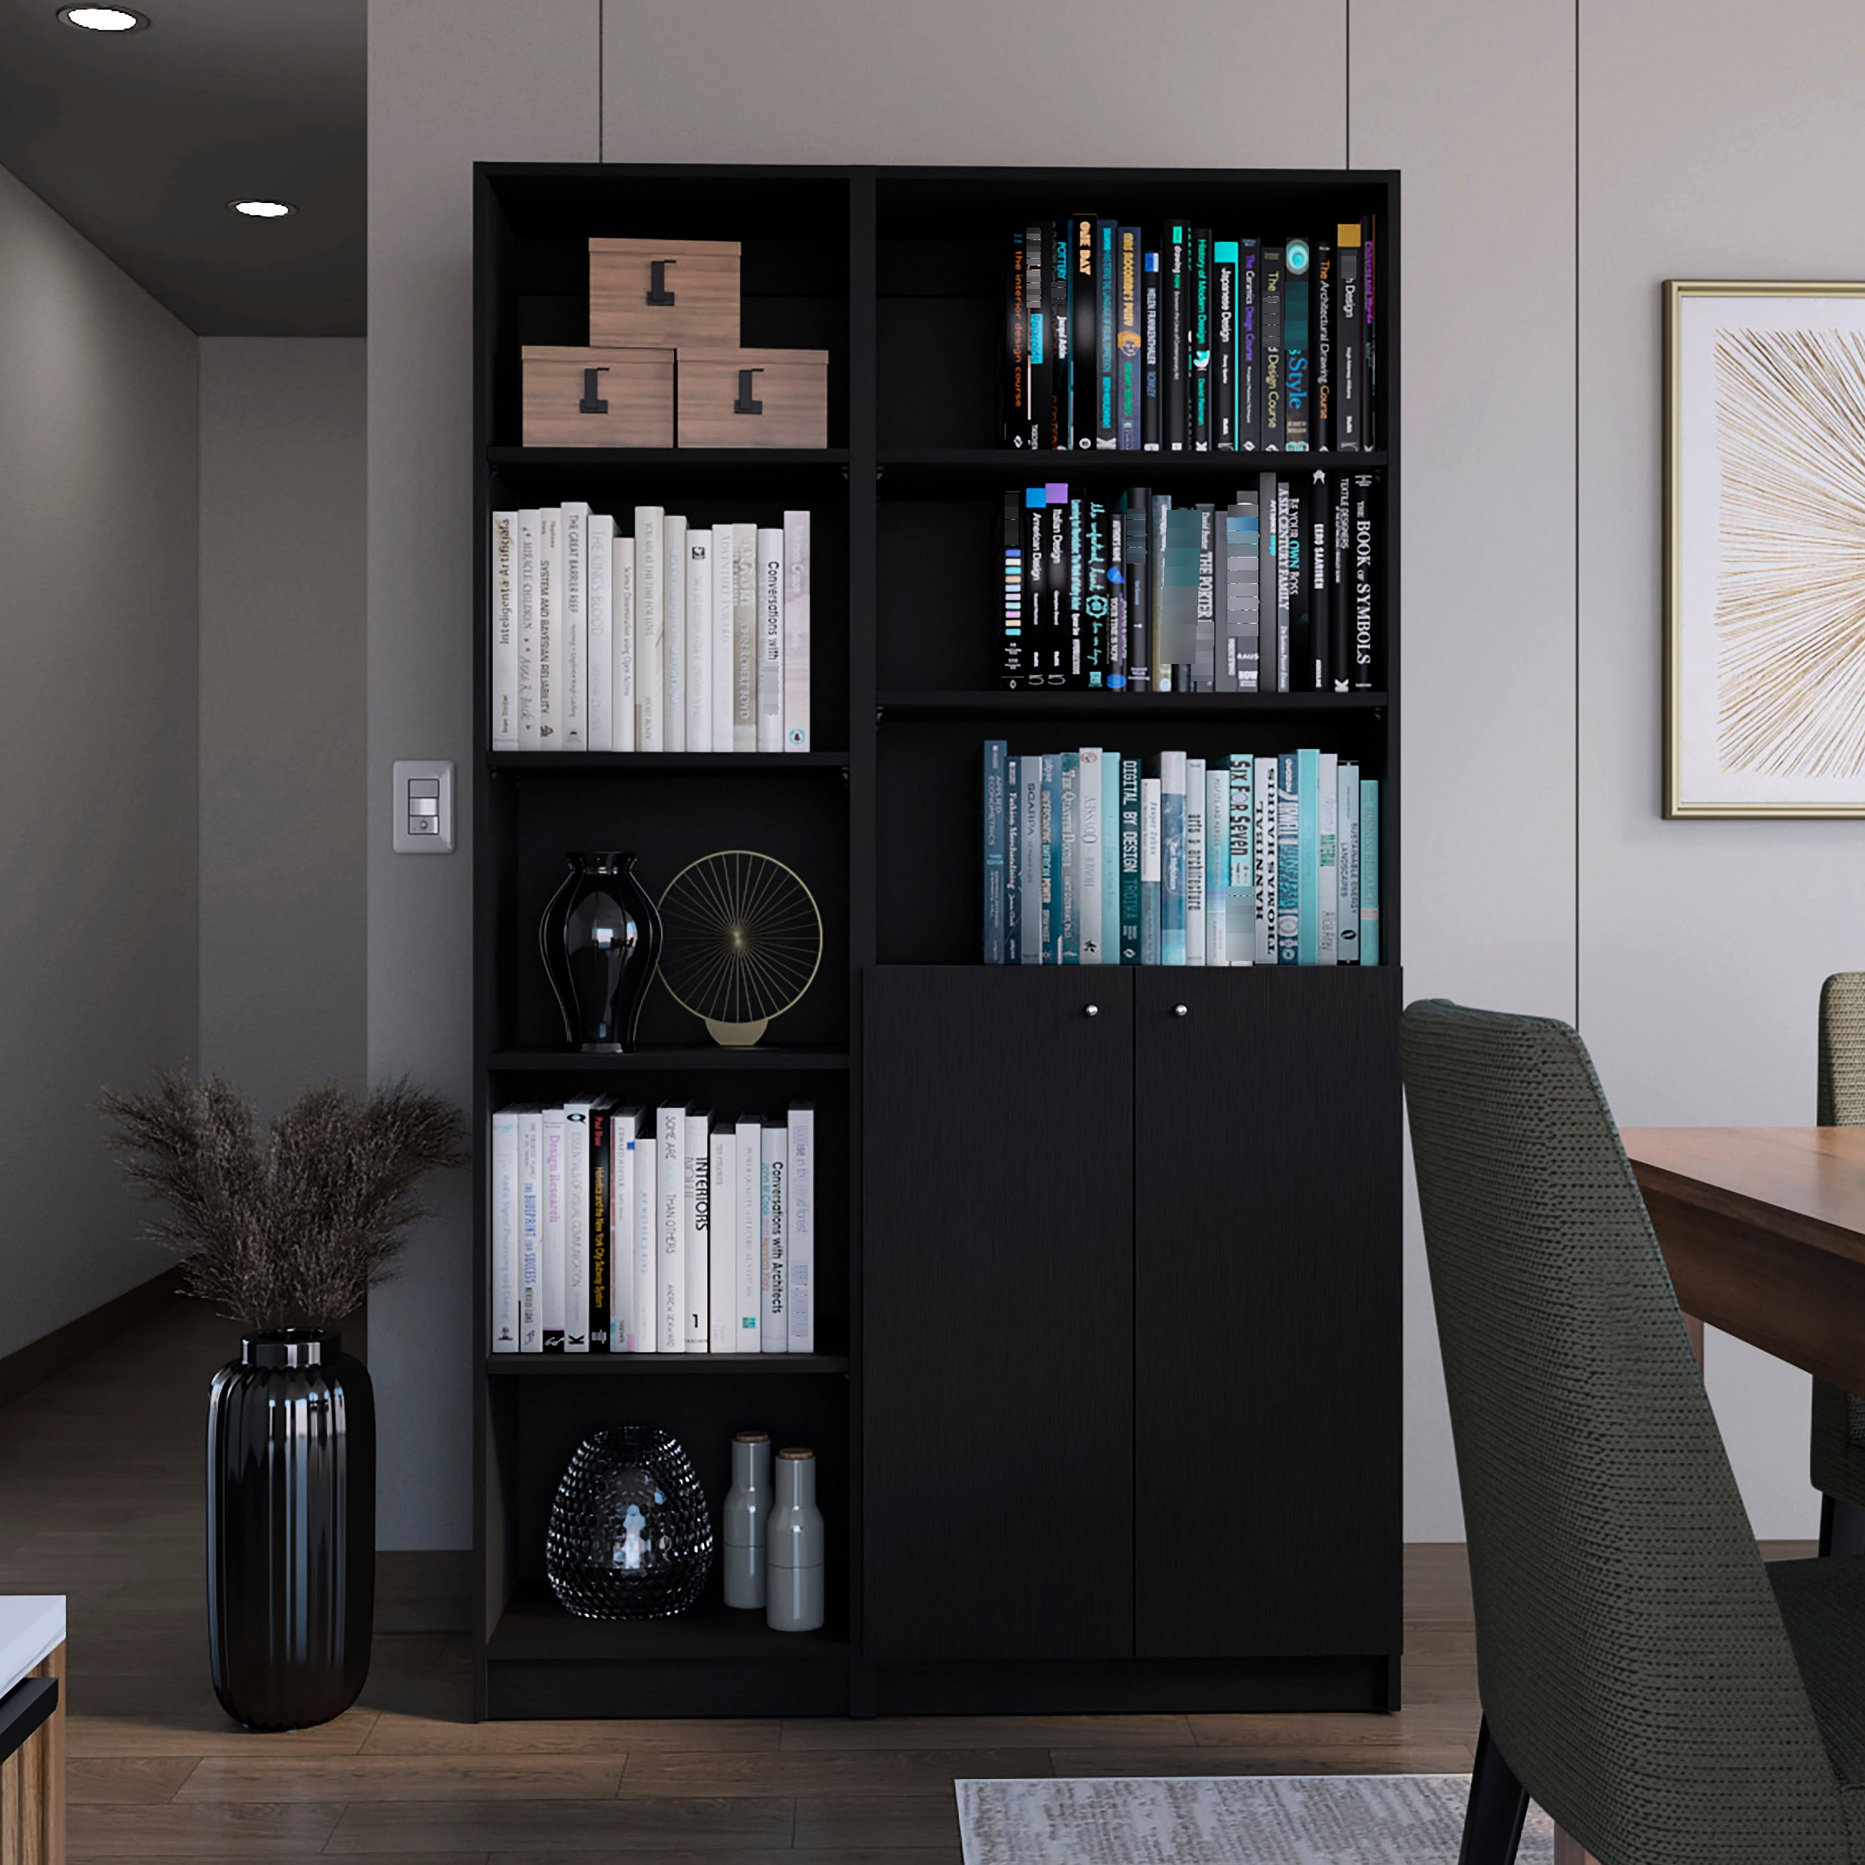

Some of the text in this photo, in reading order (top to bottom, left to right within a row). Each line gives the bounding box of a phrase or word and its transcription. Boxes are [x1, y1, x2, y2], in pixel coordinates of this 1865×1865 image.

[1057, 241, 1067, 280] POTTERY
[1079, 221, 1091, 276] ONE DAY
[1172, 245, 1182, 273] drawing
[1246, 254, 1255, 269] The
[1196, 239, 1207, 344] History of Modern Design
[1220, 267, 1232, 343] Japanese Design
[1246, 270, 1256, 305] Ceramics
[1343, 284, 1356, 318] Design
[1012, 250, 1024, 407] the interior design course
[1243, 305, 1255, 332] Design
[1318, 260, 1330, 420] The Architectural Drawing Course
[1246, 333, 1255, 361] Course
[1265, 271, 1280, 429] The Design Course
[1285, 357, 1308, 410] Style
[1340, 478, 1350, 507] TEXTILE
[644, 522, 655, 538] YOU
[1032, 512, 1042, 552] American
[1050, 508, 1063, 564] Italian Design
[1278, 488, 1290, 610] A SIX CENTURY FAMILY
[1289, 511, 1300, 538] YOUR
[568, 514, 579, 613] THE GREAT BARRIER REEF
[1031, 552, 1042, 582] Design
[1289, 540, 1300, 569] OWN
[590, 530, 605, 637] THE BLOOD
[1198, 551, 1213, 619] THE PORTER
[1289, 571, 1300, 596] BOSS
[1356, 501, 1371, 665] THE BOOK OF SYMBOLS
[540, 559, 550, 714] SYSTEM AND BAYESIAN RELIABILITY
[767, 561, 780, 661] Conversations with
[988, 775, 996, 846] ECONOMETRICS
[1027, 783, 1036, 836] SCARPA
[1149, 801, 1159, 829] Jasper
[1006, 792, 1018, 890] Fashion Merchandising
[1123, 760, 1138, 919] DIGITAL BY DESIGN TROIKA
[1188, 814, 1204, 911] arts architecture
[1255, 800, 1264, 920] HANNIBAL
[1267, 767, 1275, 956] THOMAS HARRIS
[1340, 842, 1348, 898] LANDSCAPES
[594, 1116, 604, 1131] Paul
[617, 1127, 626, 1158] EDWARD
[547, 1134, 561, 1223] Design Research
[571, 1132, 583, 1178] ESSENTIALS
[594, 1166, 604, 1194] Helvetica
[745, 1146, 753, 1209] POWER QUALITY
[763, 1162, 771, 1183] John
[501, 1174, 512, 1198] Audio
[665, 1115, 677, 1254] SOME ARE THAN OTHERS
[696, 1157, 708, 1231] INTERIORS
[501, 1199, 512, 1226] Signal
[524, 1194, 537, 1238] BLUEPRINT
[594, 1218, 604, 1232] New
[771, 1160, 784, 1314] Conversations with Architects
[501, 1227, 512, 1272] Processing
[571, 1220, 583, 1288] COMMUNICATION
[594, 1233, 604, 1246] York
[524, 1252, 537, 1284] SUCCESS
[594, 1260, 604, 1285] Subway
